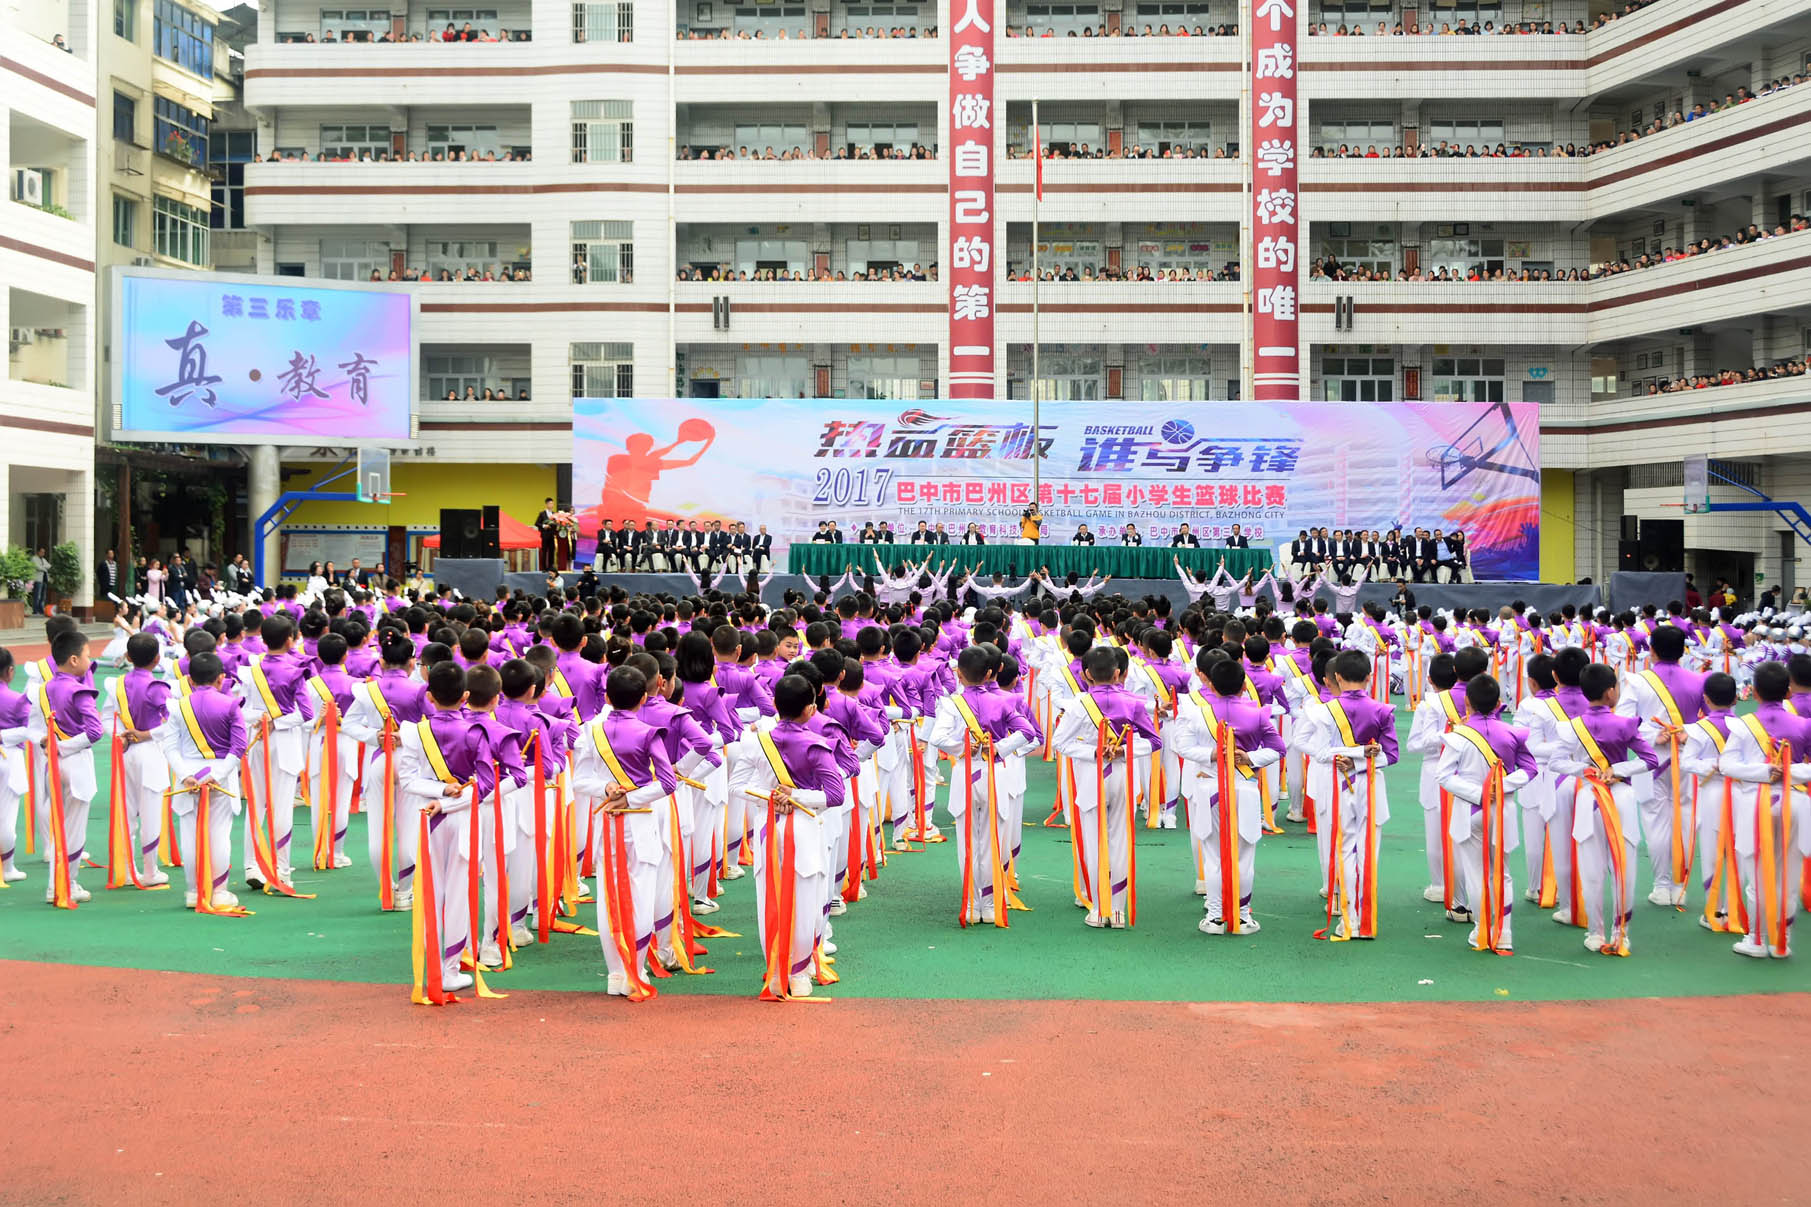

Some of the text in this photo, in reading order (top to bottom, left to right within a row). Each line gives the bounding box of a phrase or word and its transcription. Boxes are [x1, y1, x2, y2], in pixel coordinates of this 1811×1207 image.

[221, 294, 322, 321] 第三乐章
[1084, 425, 1153, 436] BASKETBALL
[814, 416, 1304, 473] 热血篮板 谁与争锋
[813, 467, 1286, 506] 2017 巴中市巴州区第十七届小学生篮球比赛
[899, 507, 1285, 519] THE 17TH PRIMARY SCHOOL SKETBALL GAME IN BAZHOU DISTRICT, BAZHONG CITY
